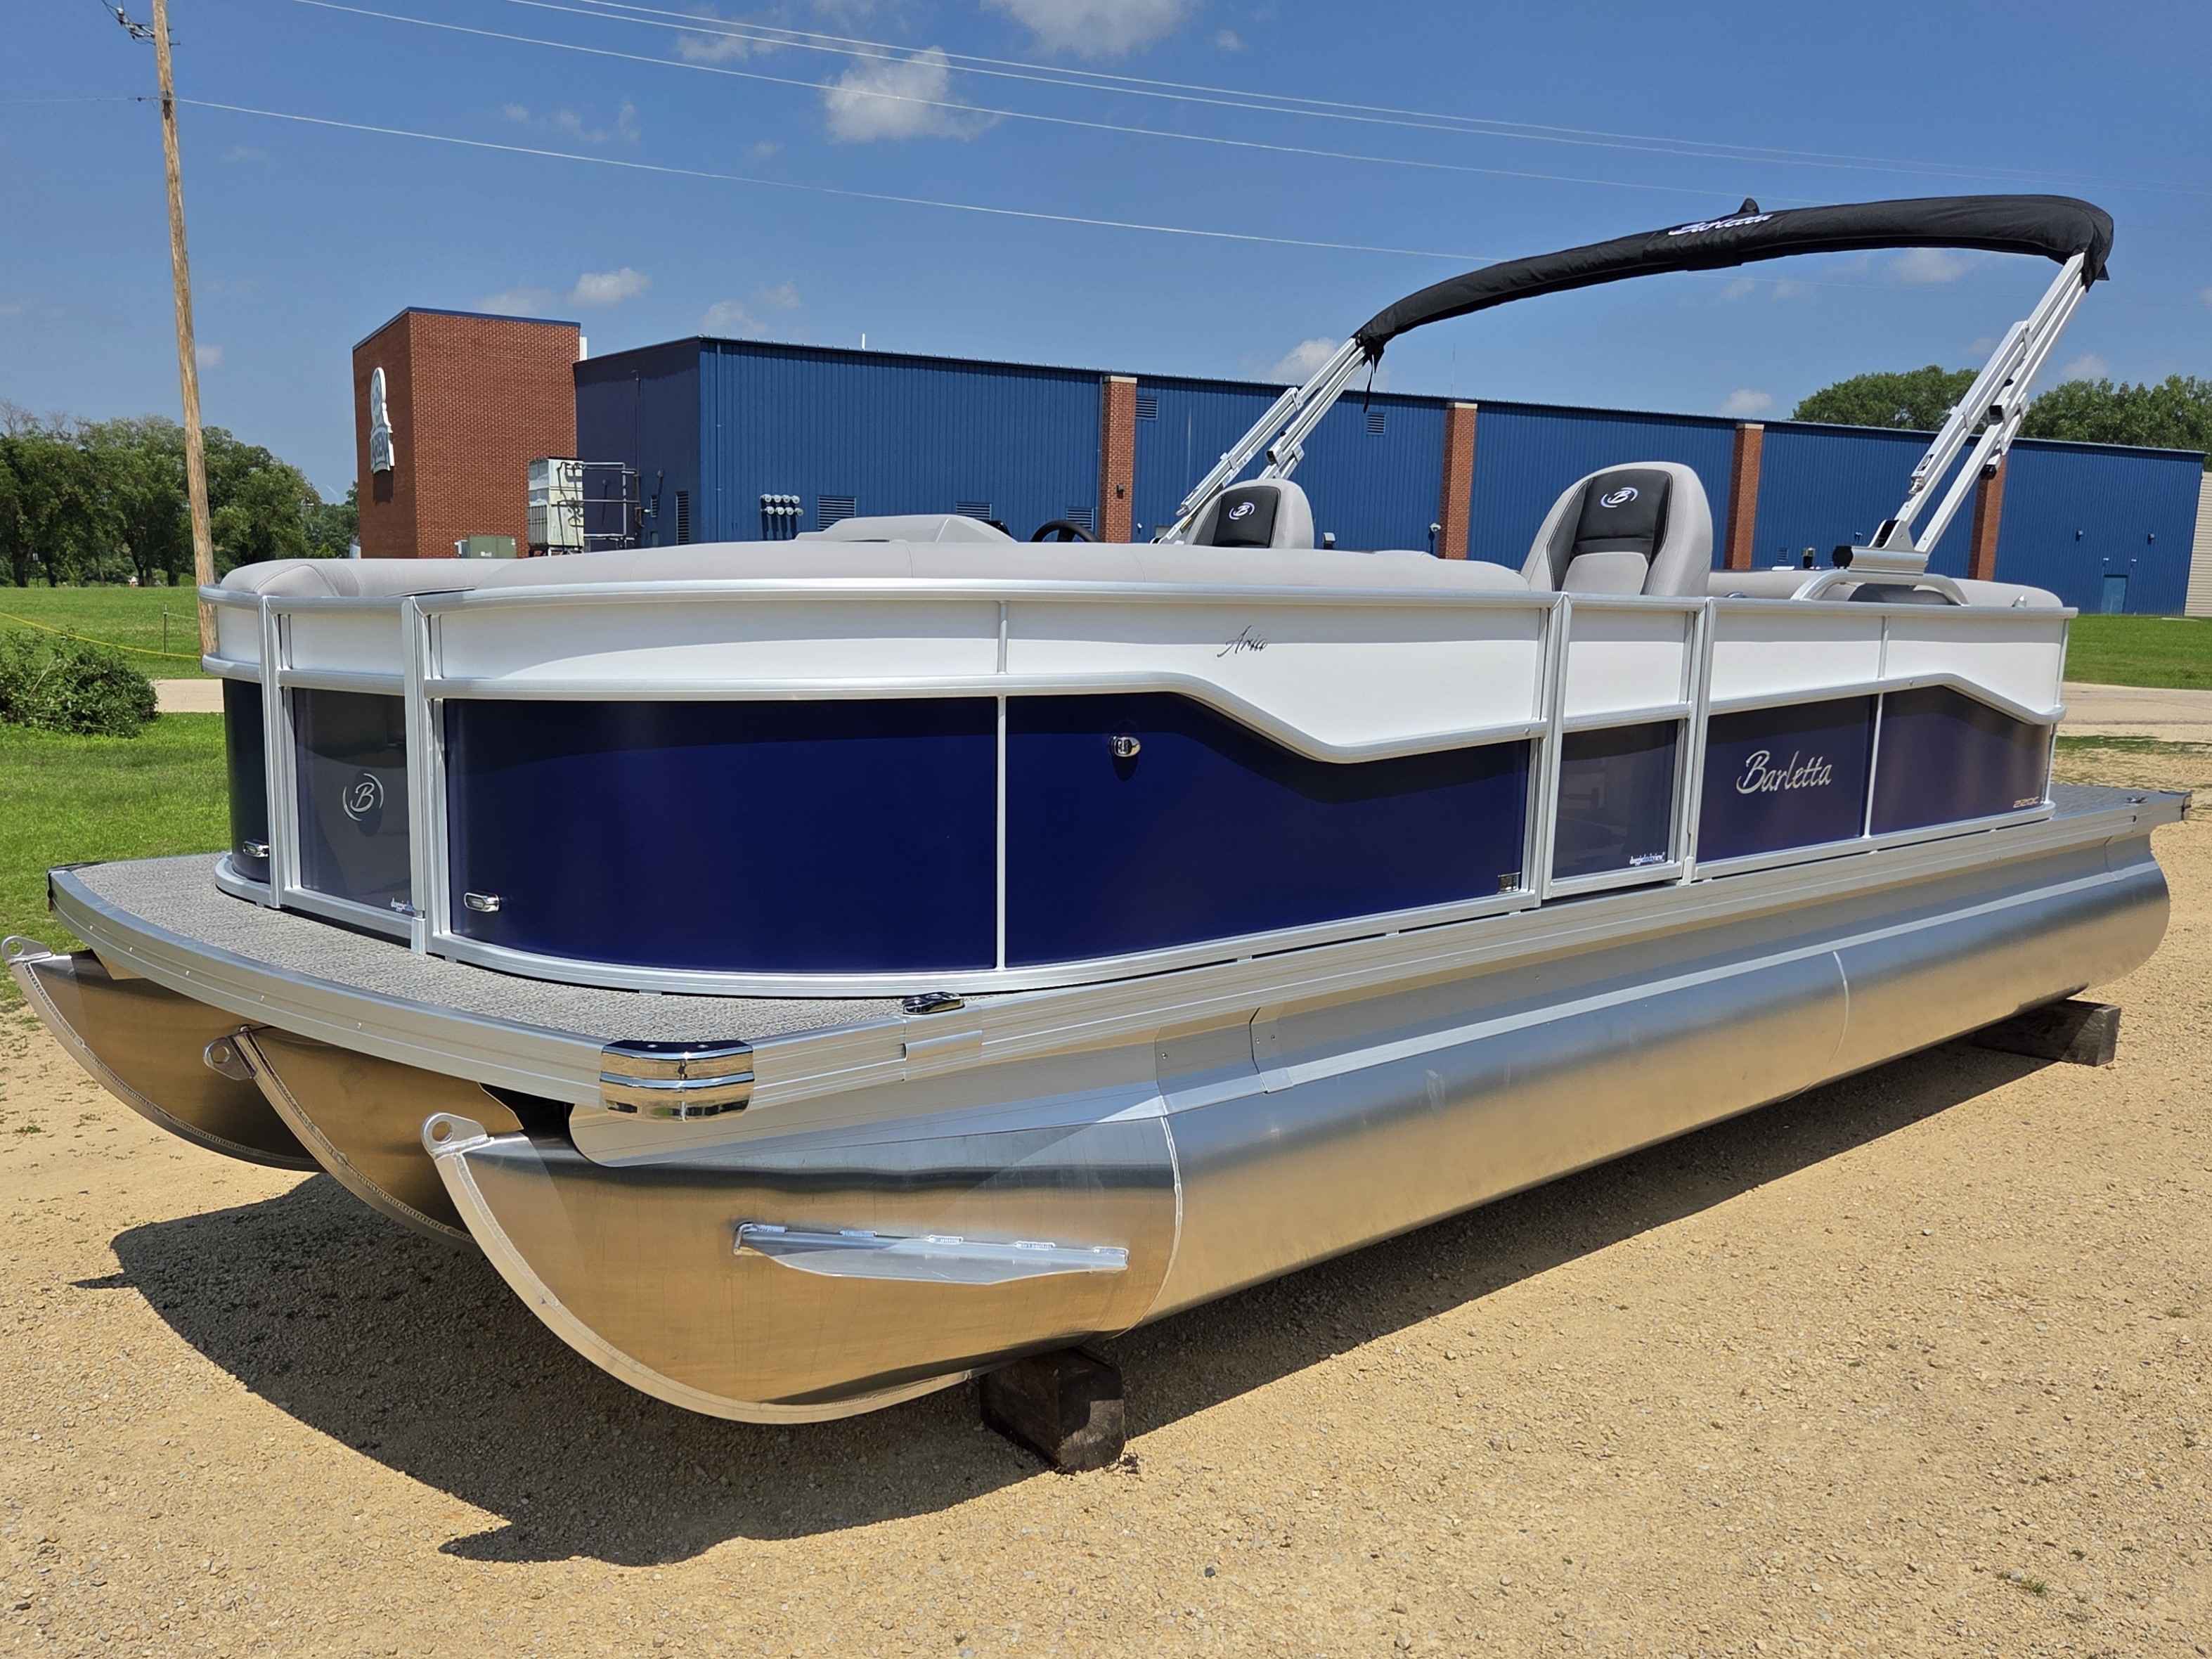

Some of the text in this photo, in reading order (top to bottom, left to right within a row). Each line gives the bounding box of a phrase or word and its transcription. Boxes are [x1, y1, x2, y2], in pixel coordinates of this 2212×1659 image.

[1217, 624, 1268, 658] Aria
[1736, 749, 1832, 794] Barletta
[350, 782, 375, 812] B
